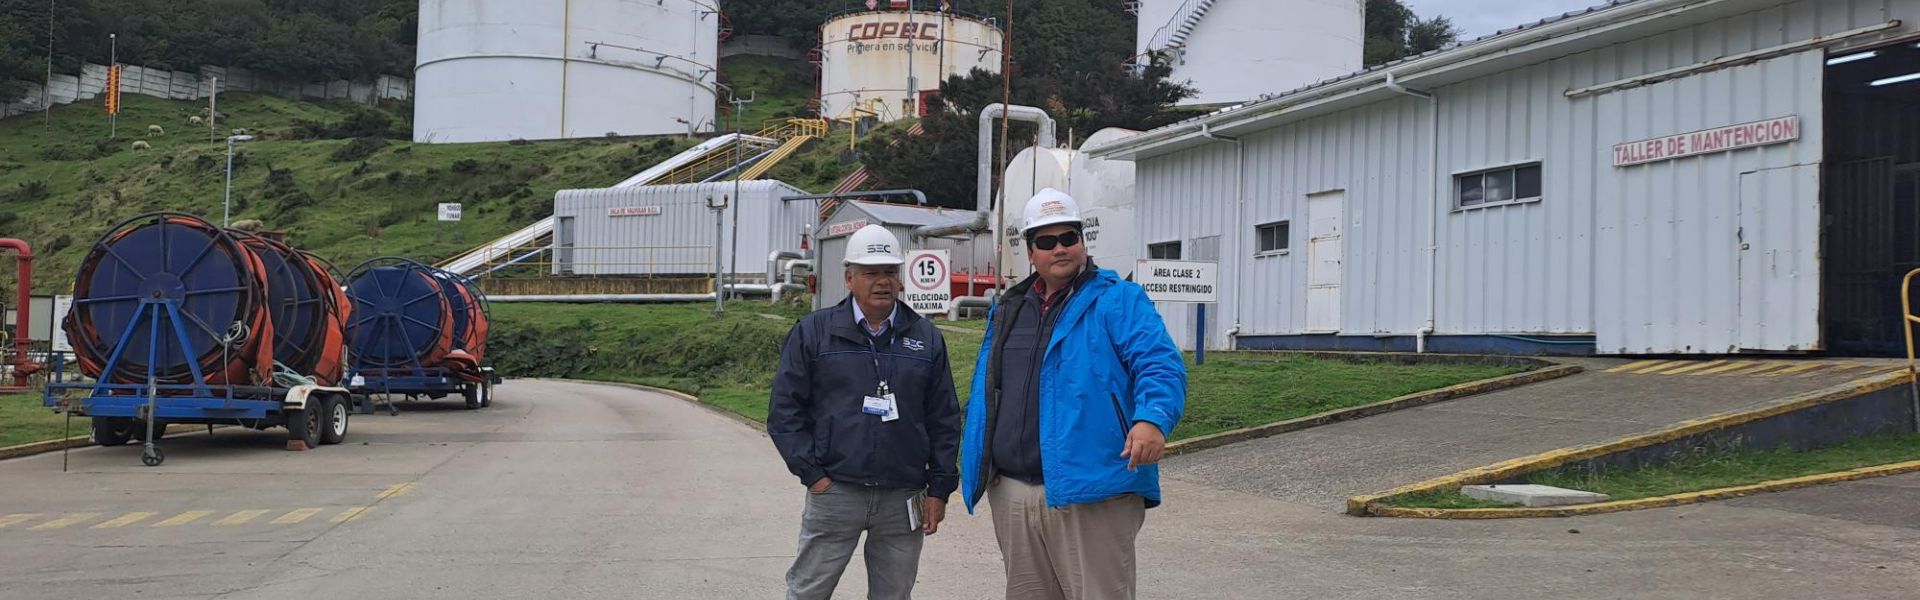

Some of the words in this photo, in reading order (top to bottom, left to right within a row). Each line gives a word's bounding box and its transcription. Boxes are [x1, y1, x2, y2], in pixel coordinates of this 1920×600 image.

[848, 22, 938, 42] COPEC
[882, 42, 895, 50] en
[1614, 140, 1664, 164] TALLER
[1667, 136, 1685, 154] DE
[1691, 118, 1795, 152] MANTENCION
[867, 244, 891, 253] SEC
[918, 260, 935, 276] 15
[1172, 268, 1193, 278] CLASE
[1196, 269, 1201, 279] 2
[1168, 283, 1212, 294] RESTRINGIDO
[907, 293, 949, 301] VELOCIDAD
[912, 302, 943, 310] MAXIMA
[902, 336, 924, 349] SEC
